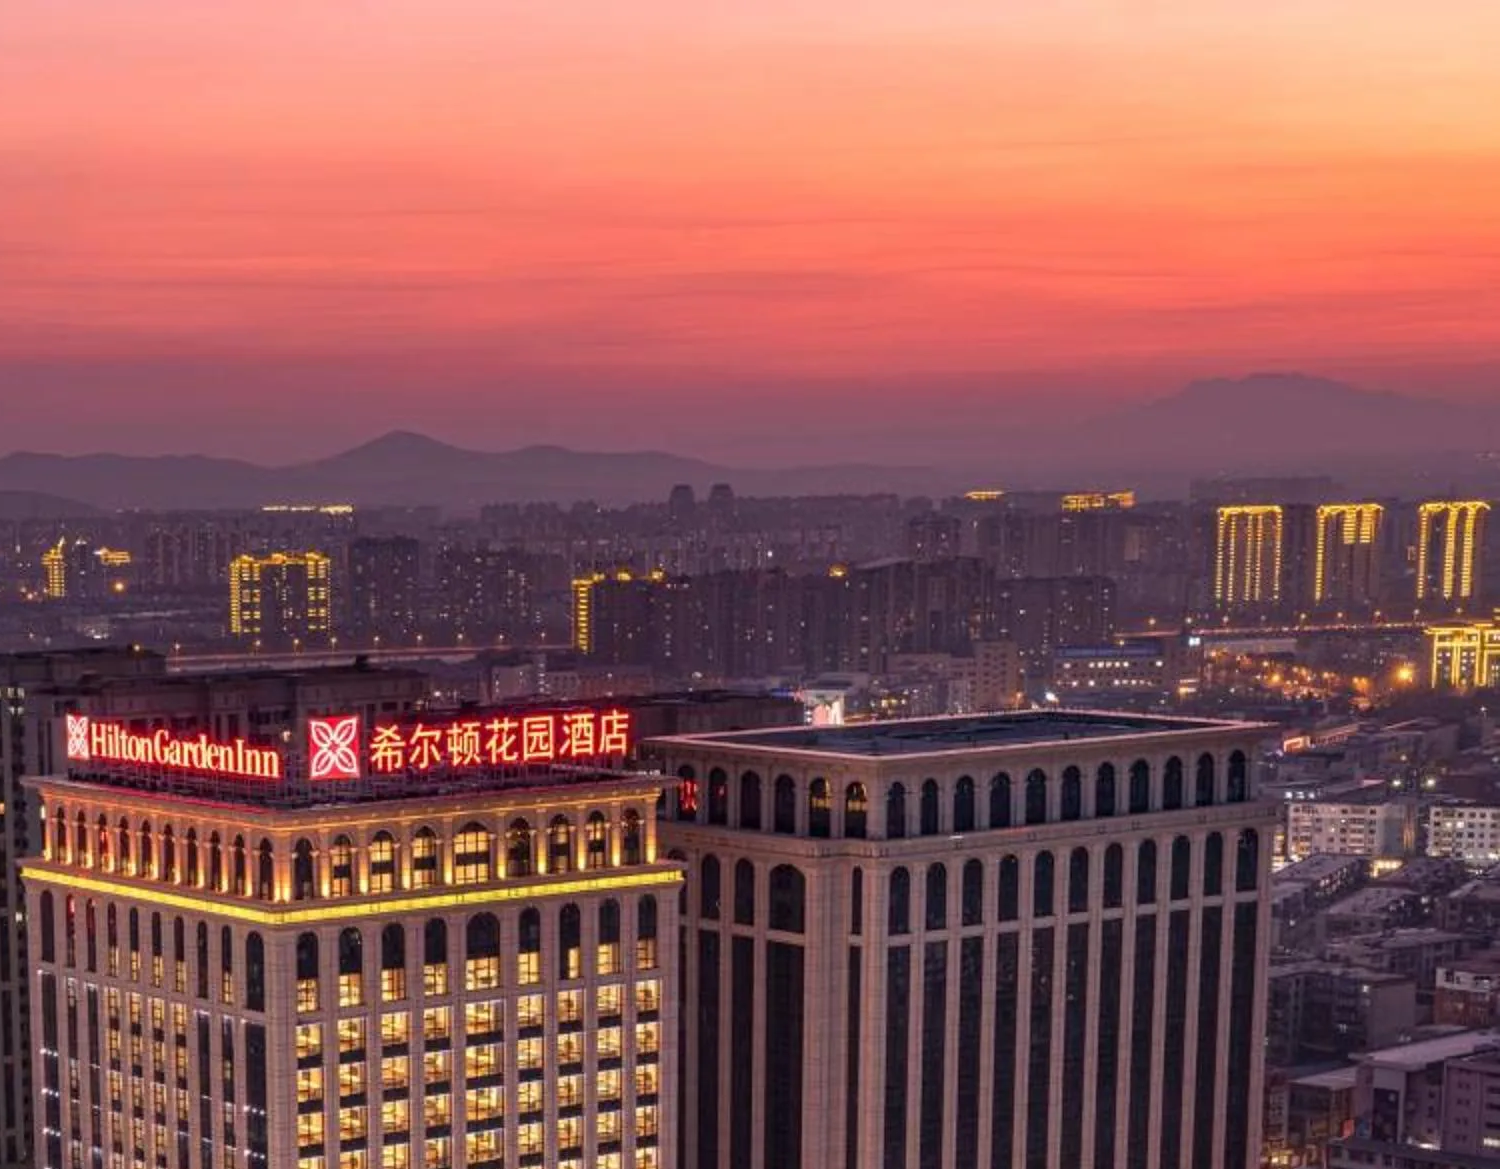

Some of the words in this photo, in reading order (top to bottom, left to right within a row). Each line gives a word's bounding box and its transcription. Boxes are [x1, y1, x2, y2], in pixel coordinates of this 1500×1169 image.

[369, 708, 629, 773] 希尔顿花园酒店
